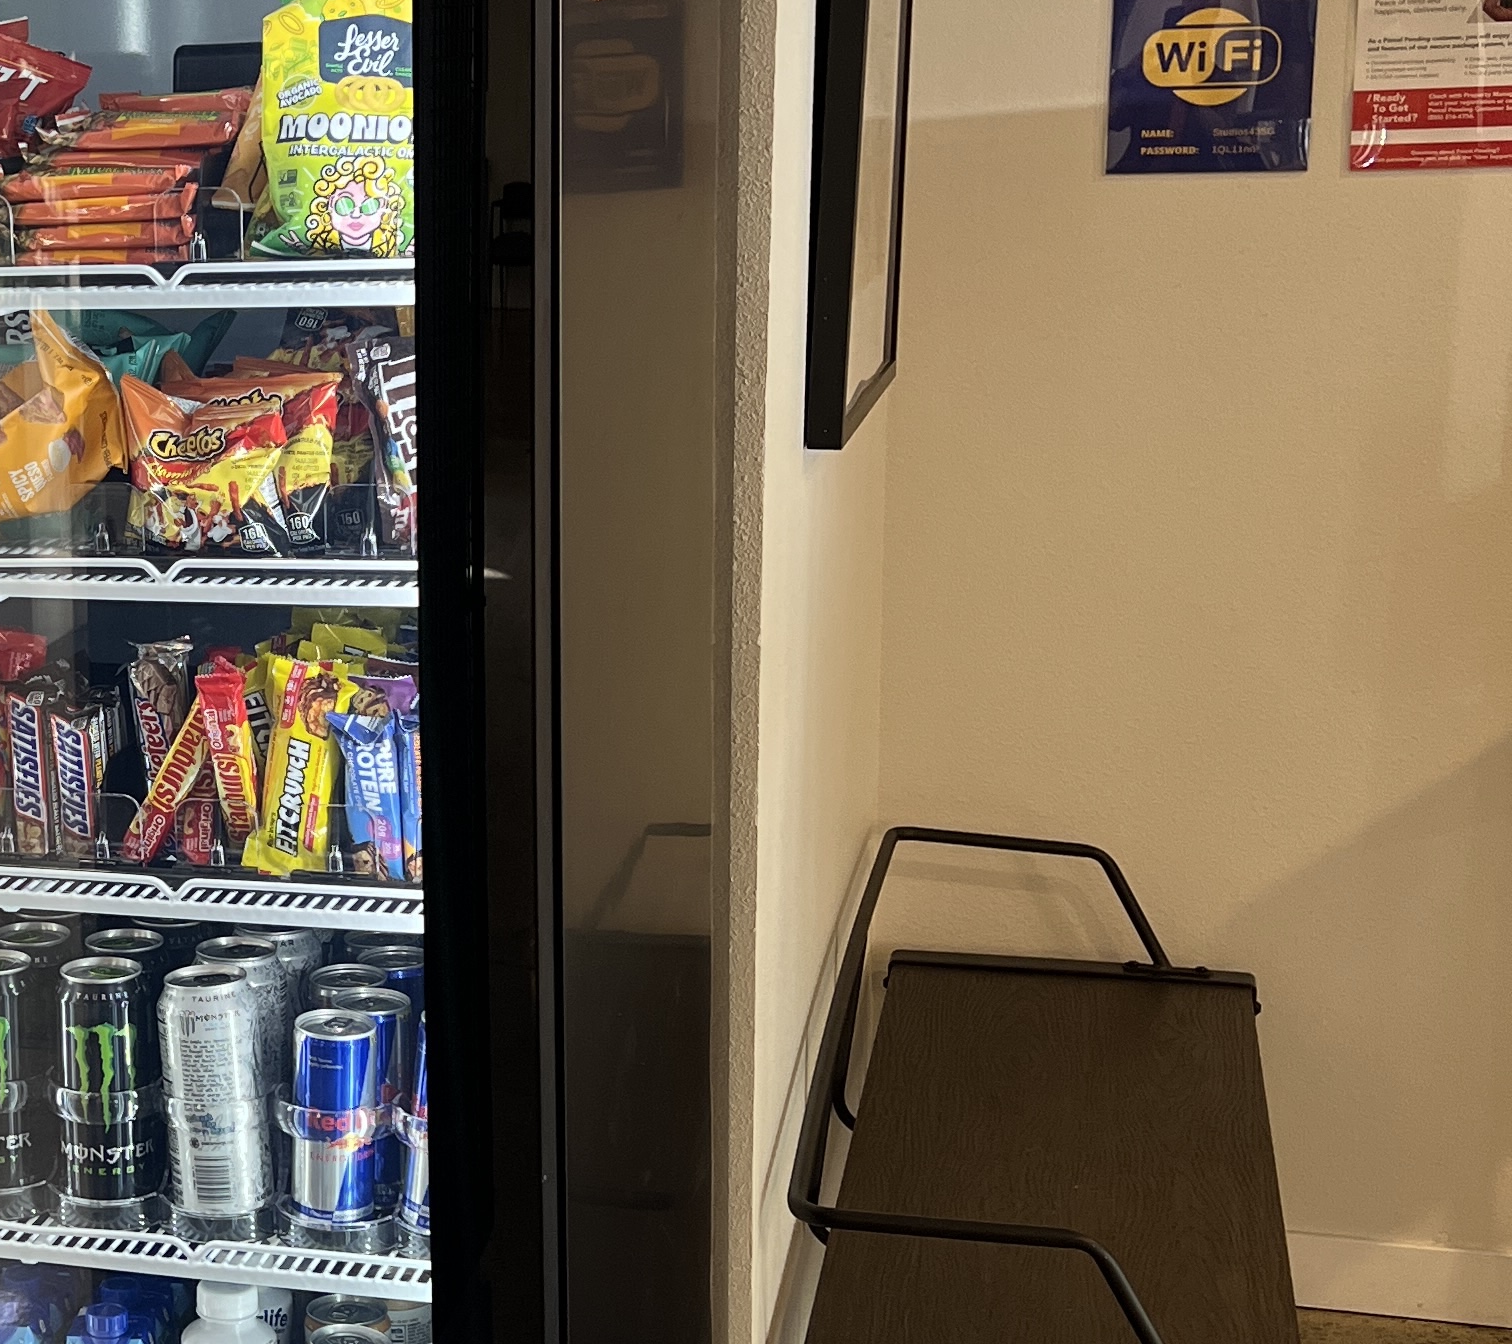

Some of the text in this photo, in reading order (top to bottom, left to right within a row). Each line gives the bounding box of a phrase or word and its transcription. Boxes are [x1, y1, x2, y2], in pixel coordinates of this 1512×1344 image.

[333, 23, 400, 62] Lesser
[1155, 38, 1262, 74] WiFi
[346, 46, 395, 77] Evil
[276, 78, 320, 100] ORGANIC
[278, 86, 323, 109] AVOCADO
[1372, 92, 1406, 104] Ready
[1372, 102, 1409, 113] To Get
[1372, 112, 1419, 124] Started?
[275, 111, 414, 144] MOONIO
[288, 143, 395, 159] INTERGALACTIC
[149, 426, 225, 461] Cheetos
[8, 468, 35, 503] SPICY
[24, 460, 46, 493] QUESO
[289, 514, 309, 531] 160
[339, 511, 361, 526] 160
[8, 698, 45, 822] SATISFIES
[54, 718, 92, 837] SATISFIES
[355, 742, 383, 813] ROTEIN
[76, 991, 130, 1002] TAURINE
[191, 991, 237, 1003] TAURINE
